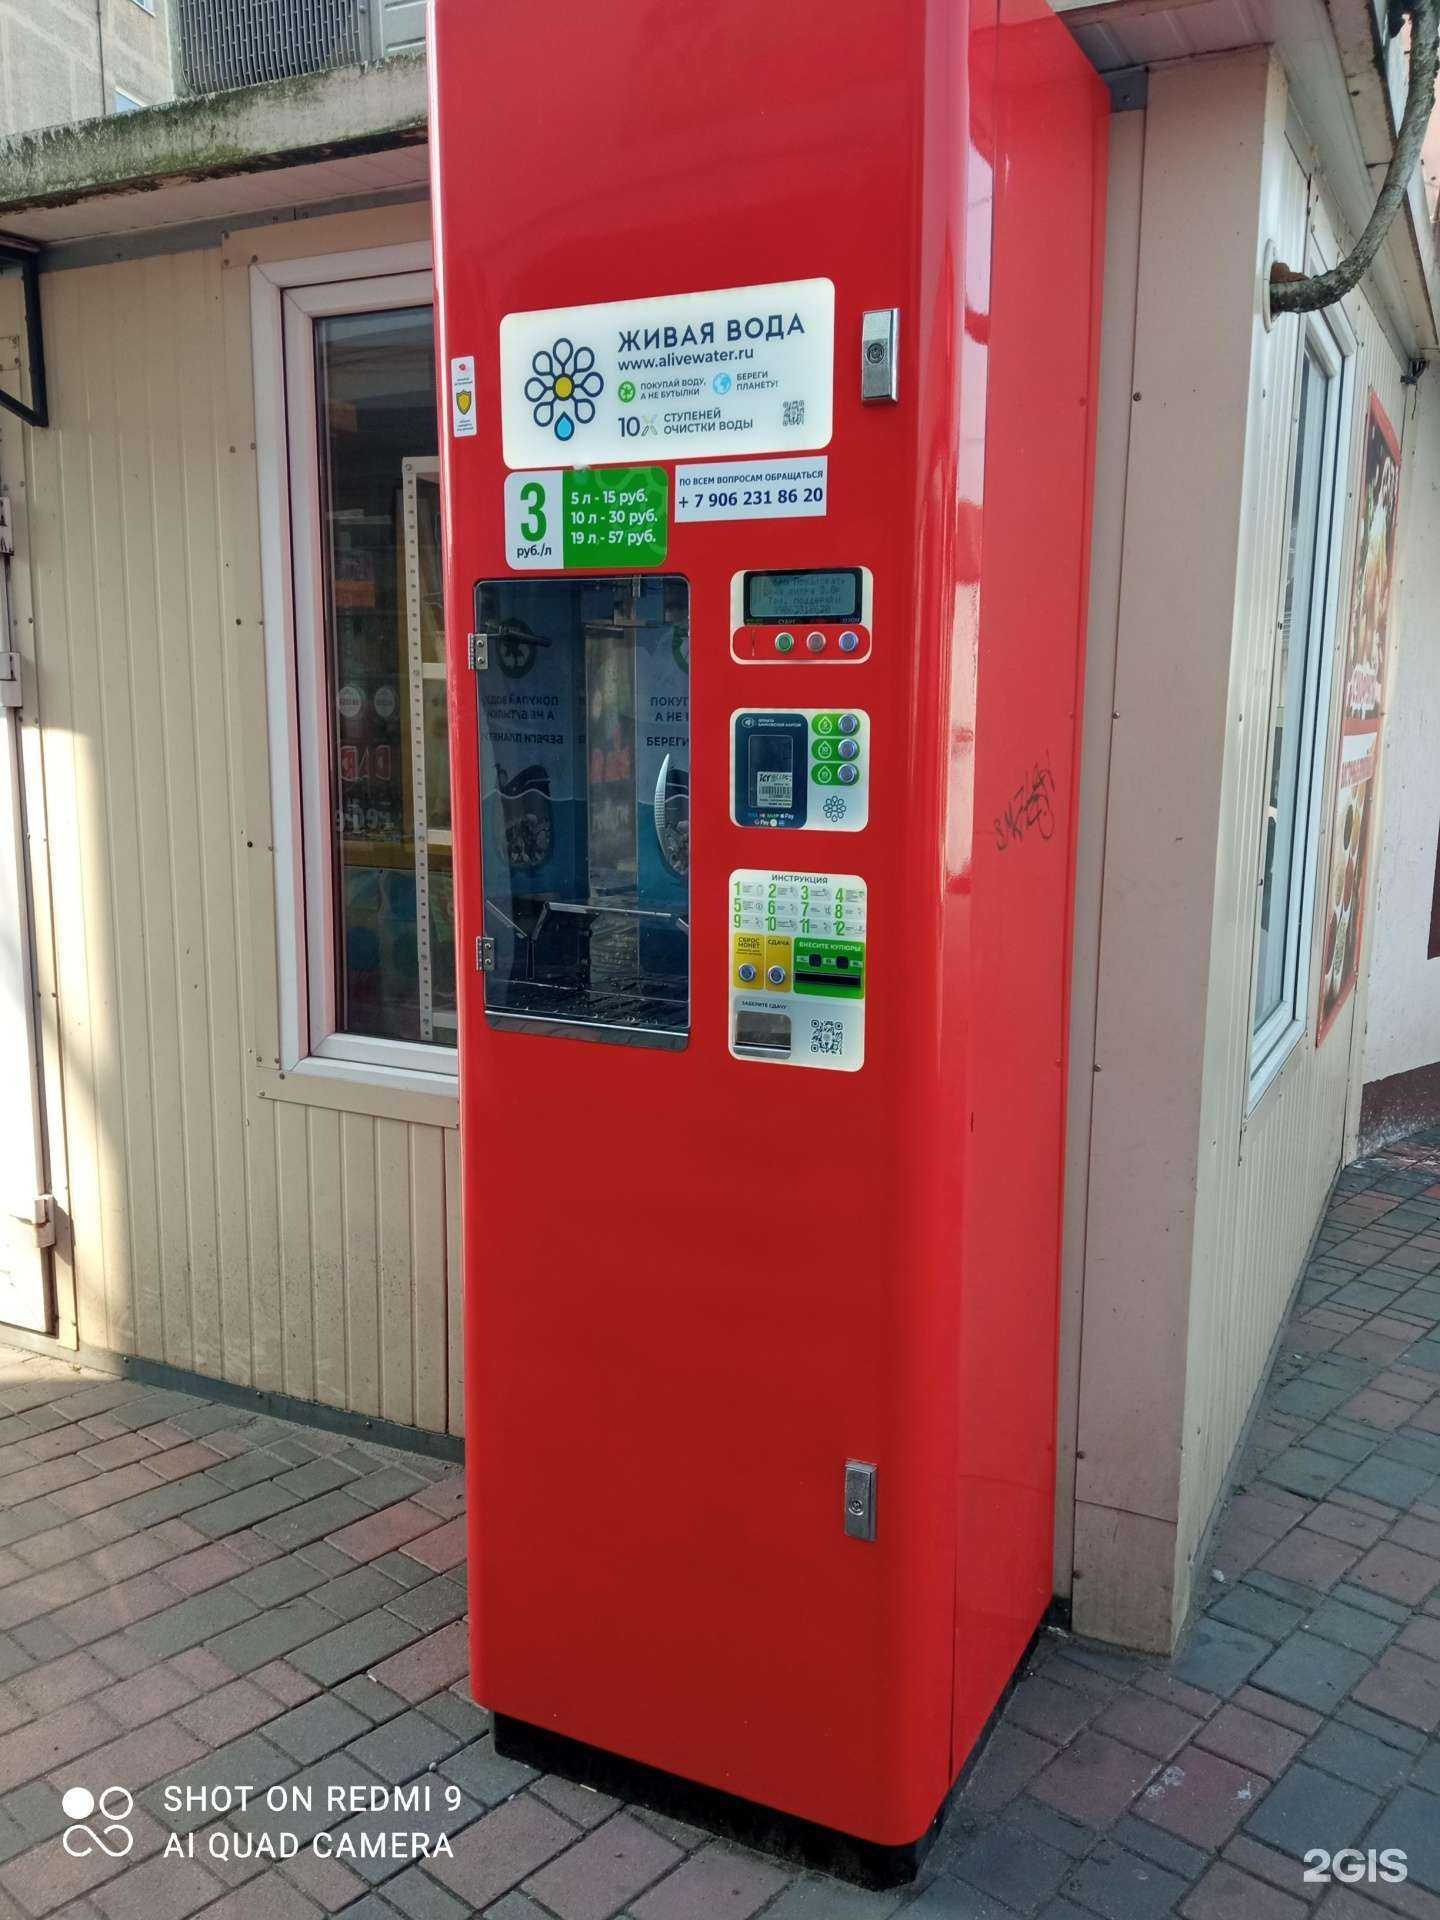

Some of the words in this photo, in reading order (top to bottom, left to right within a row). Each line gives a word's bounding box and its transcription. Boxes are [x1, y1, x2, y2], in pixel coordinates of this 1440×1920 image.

[618, 322, 714, 352] ЖИВАЯ
[727, 313, 805, 341] ВОДА
[618, 348, 754, 371] www.alivewater.ru
[736, 371, 768, 381] БЕРЕГИ
[641, 379, 680, 390] ПОКУПАЙ
[736, 381, 778, 391] ПЛАНЕТУ!
[649, 391, 659, 399] НЕ
[661, 388, 700, 398] БУТЫЛКИ
[664, 408, 721, 423] СТУПЕНЕЙ
[664, 421, 715, 435] ОЧИСТКИ
[719, 419, 753, 430] ВОДЫ
[680, 478, 691, 486] ПО
[693, 476, 715, 485] ВСЕМ
[717, 474, 762, 484] ВОПРОСАМ
[765, 470, 823, 481] ОБРАЩАТЬСЯ
[571, 492, 579, 504] 5
[582, 495, 591, 504] л
[603, 490, 616, 503] 15
[619, 488, 648, 506] руб.
[695, 494, 704, 508] 7
[708, 492, 738, 507] 906
[743, 490, 772, 505] 231
[778, 488, 798, 503] 86
[803, 487, 823, 502] 20
[520, 482, 547, 542] 3
[571, 511, 585, 524] 10
[588, 514, 597, 524] л
[609, 510, 625, 523] 30
[629, 508, 658, 525] руб.
[571, 531, 584, 544] 19
[587, 534, 597, 544] л
[608, 530, 624, 543] 57
[627, 529, 656, 545] руб.
[517, 543, 552, 558] руб./л
[655, 711, 664, 721] А
[667, 711, 681, 721] НЕ
[771, 874, 828, 884] ИНСТРУКЦИЯ
[734, 881, 741, 895] 1
[768, 884, 777, 898] 2
[801, 886, 809, 900] 3
[835, 888, 844, 902] 4
[734, 898, 742, 912] 5
[768, 900, 776, 915] 6
[801, 902, 810, 917] 7
[835, 905, 843, 919] 8
[734, 914, 742, 928] 9
[765, 917, 777, 931] 10
[800, 919, 810, 934] 11
[833, 920, 845, 936] 12
